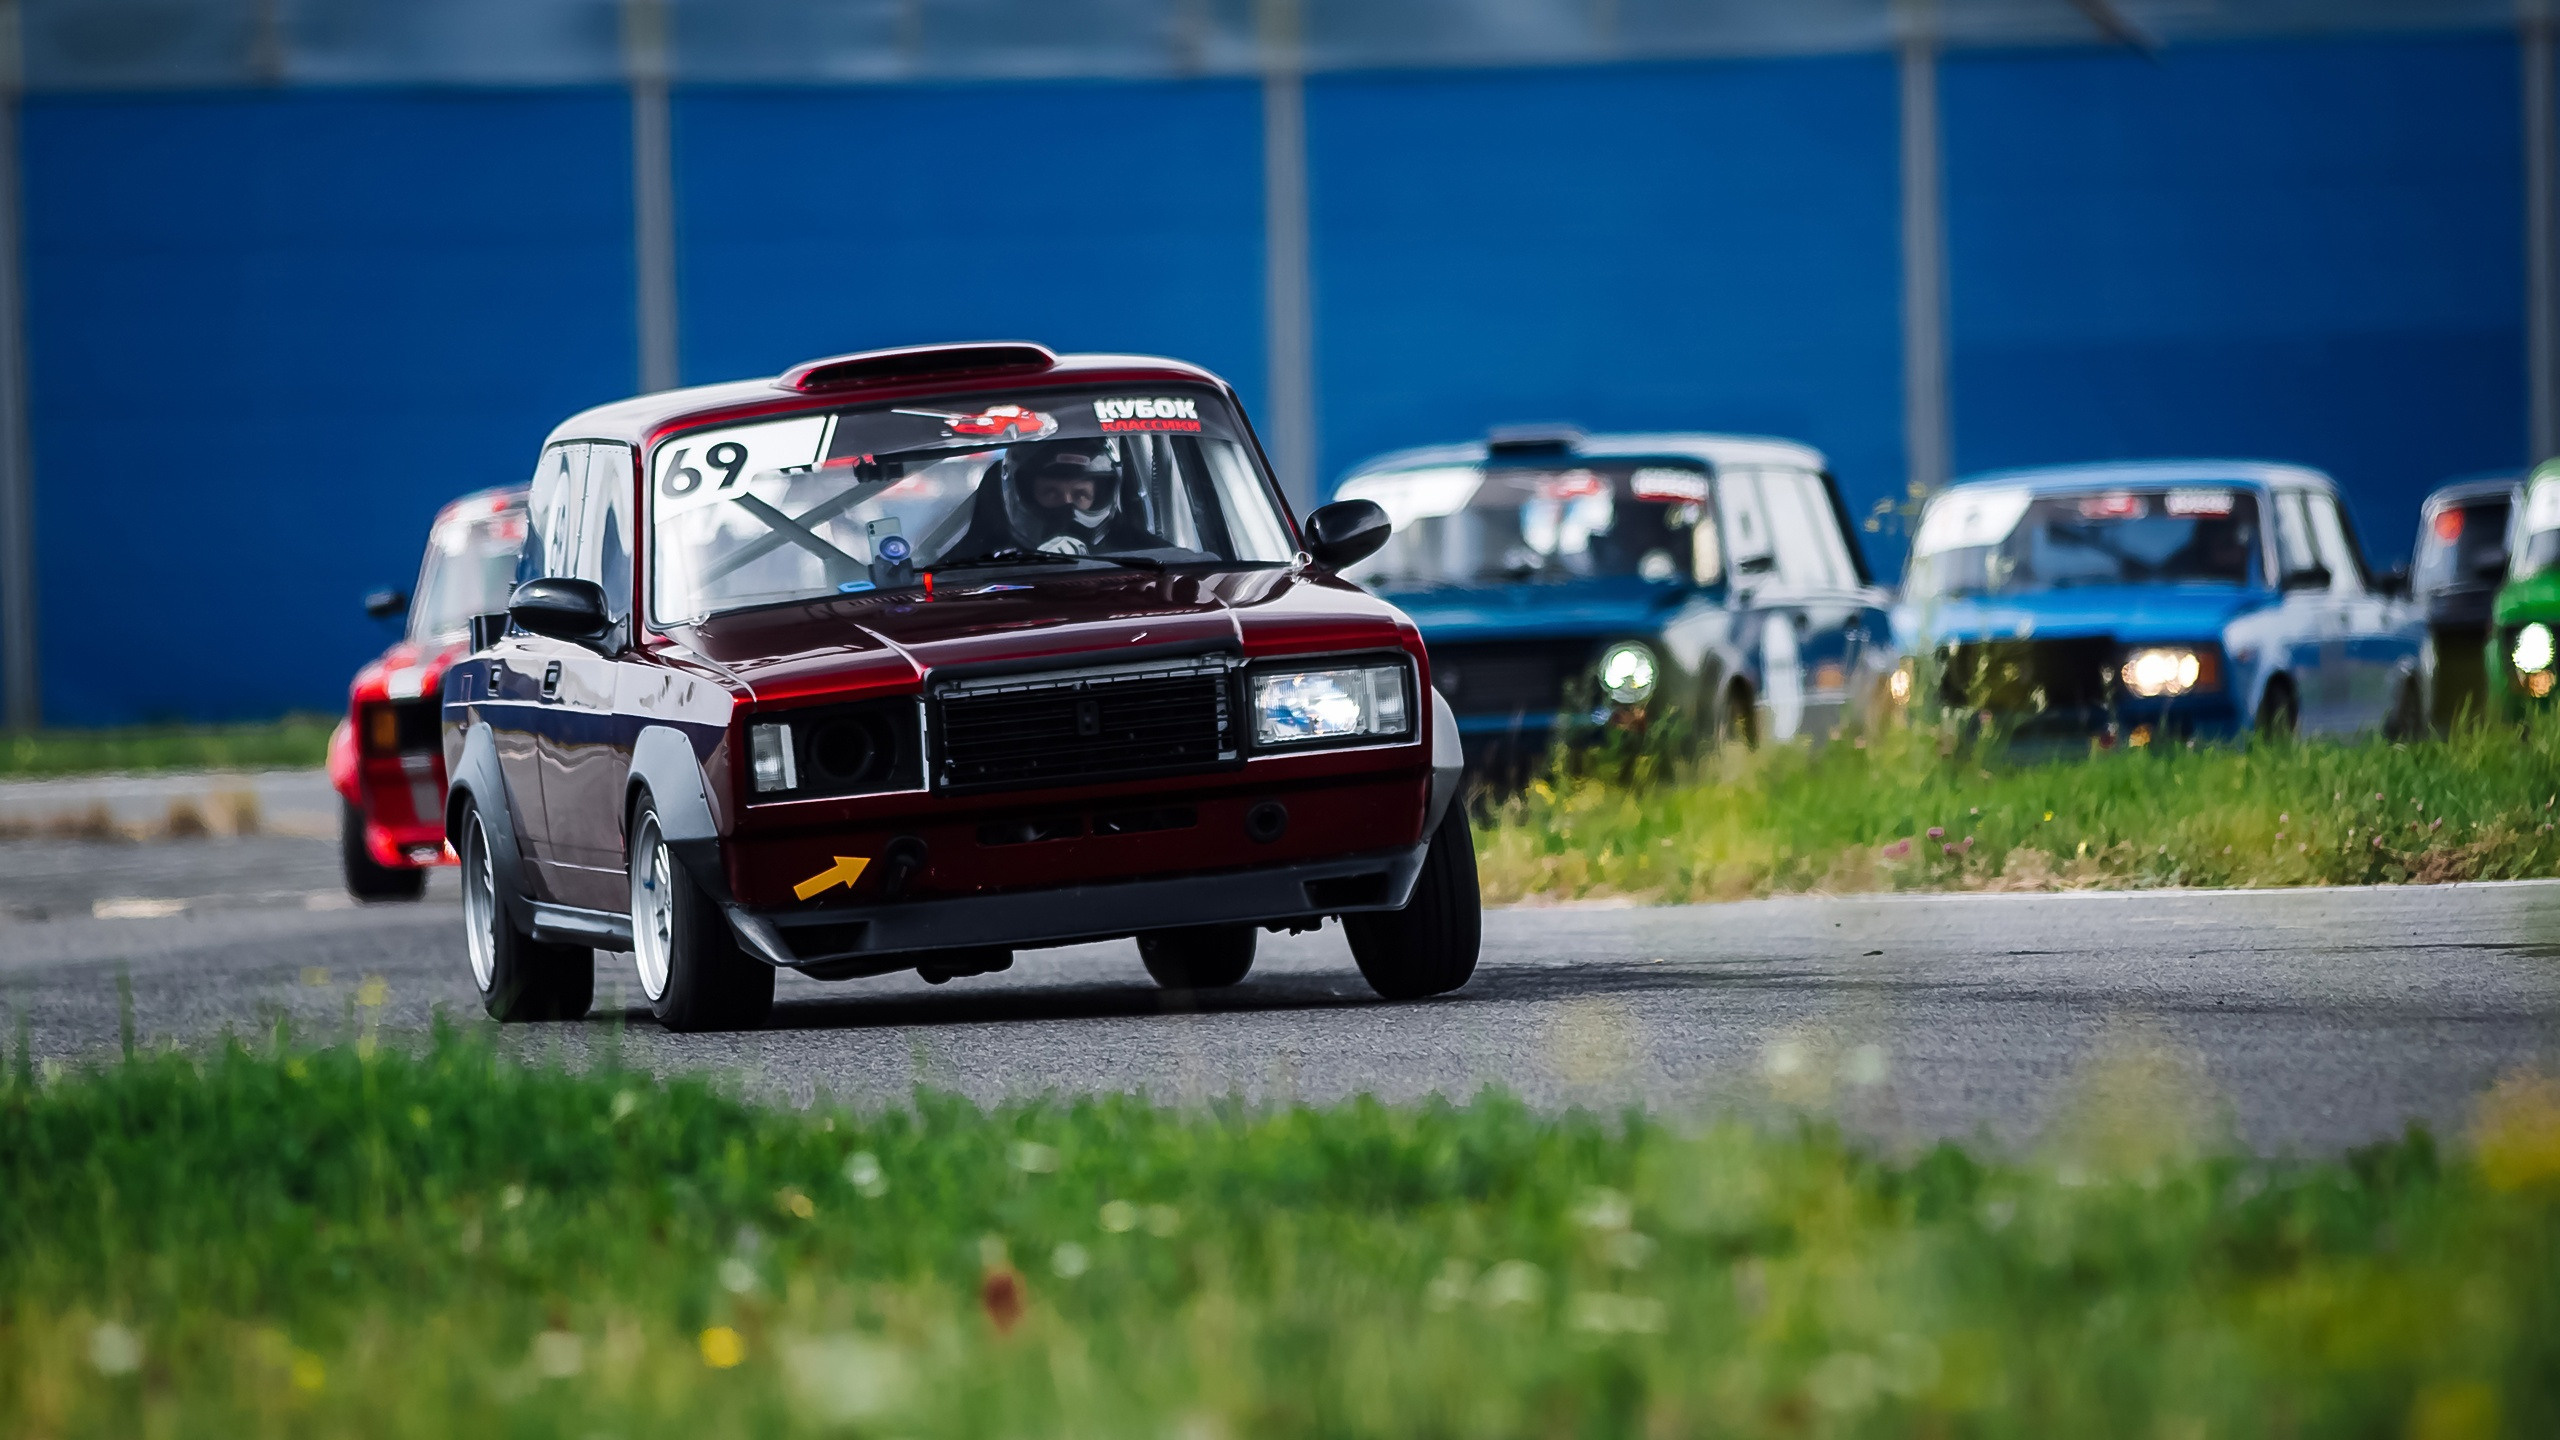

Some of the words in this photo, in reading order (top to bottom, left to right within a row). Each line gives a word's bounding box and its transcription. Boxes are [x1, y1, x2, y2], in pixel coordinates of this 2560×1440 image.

[1094, 398, 1198, 419] КУБОК
[1101, 420, 1201, 432] КЛАССИКИ
[662, 441, 748, 499] 69
